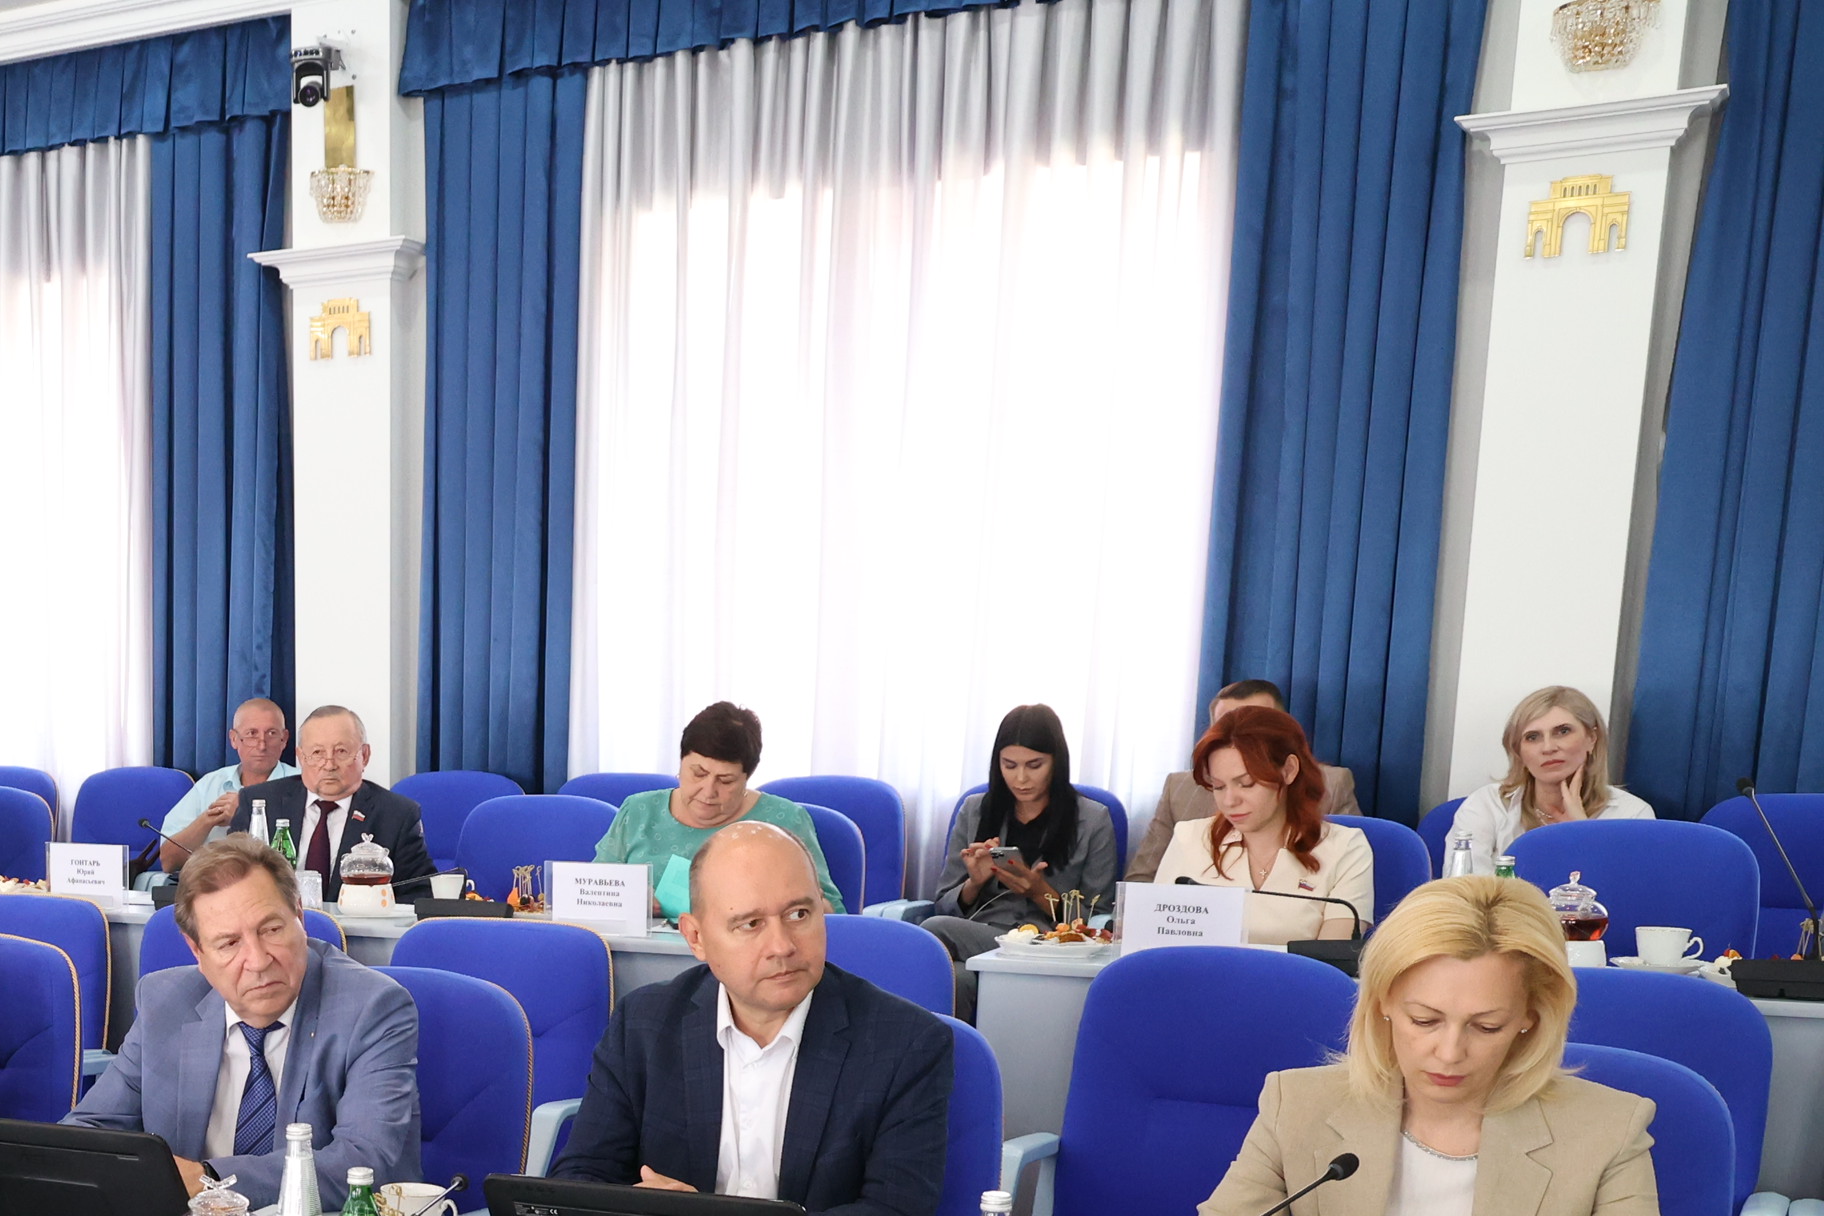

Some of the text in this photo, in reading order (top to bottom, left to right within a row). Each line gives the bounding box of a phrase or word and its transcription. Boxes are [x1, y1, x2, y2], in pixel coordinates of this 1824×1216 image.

[575, 877, 625, 887] МУРАВЬЕВА
[579, 888, 620, 897] Валентина
[576, 898, 623, 908] Николаевна
[1154, 903, 1209, 914] ДРОЗДОВА
[1166, 915, 1196, 925] Ольга
[1157, 926, 1203, 937] Павловна
